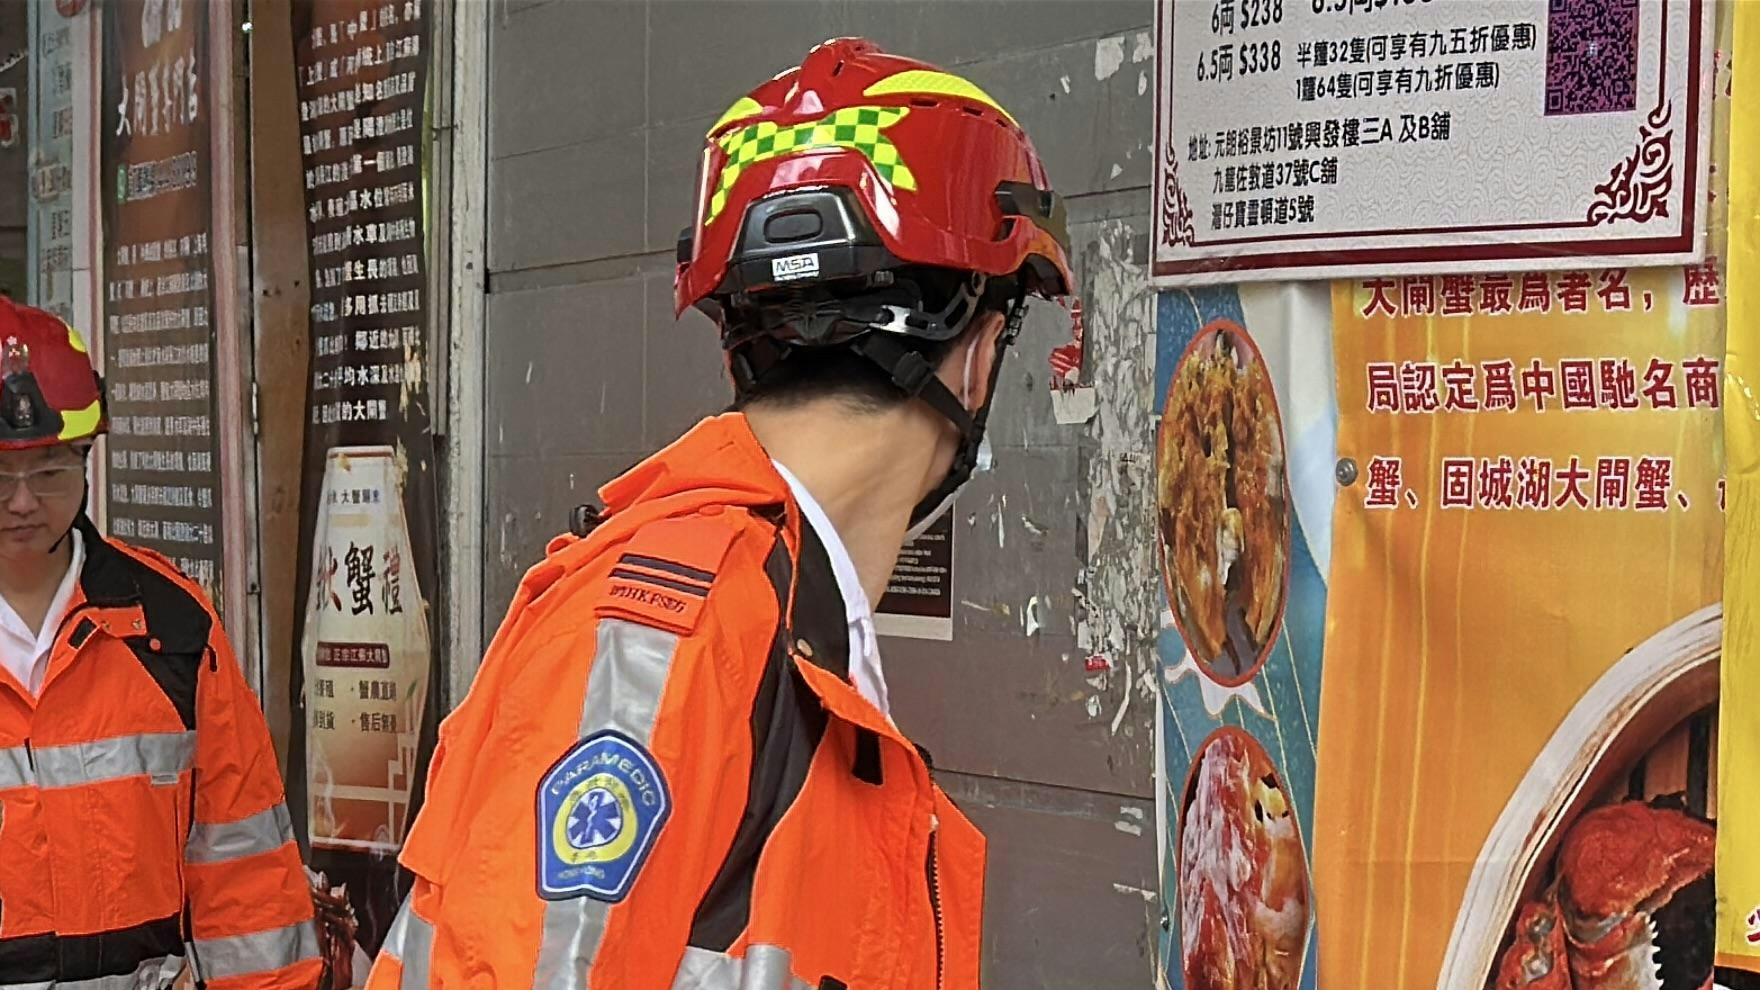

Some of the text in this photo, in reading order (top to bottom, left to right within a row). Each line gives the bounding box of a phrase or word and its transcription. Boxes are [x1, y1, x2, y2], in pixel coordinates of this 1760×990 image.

[1240, 0, 1283, 30] $238
[1239, 39, 1281, 77] $338
[776, 257, 815, 272] MSA
[551, 751, 656, 806] PARAMEDIC
